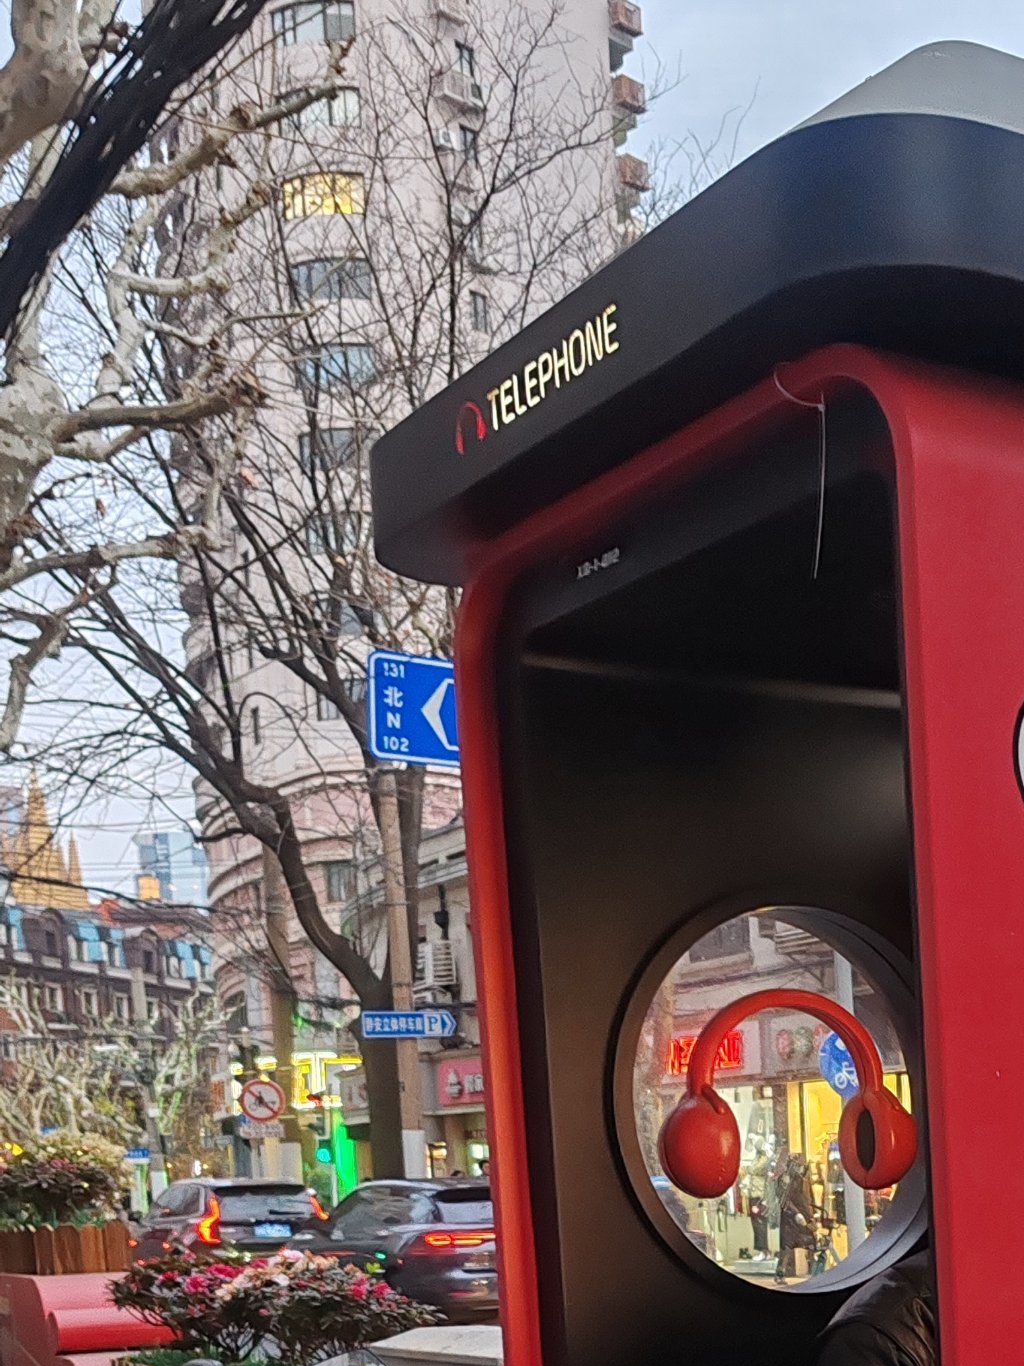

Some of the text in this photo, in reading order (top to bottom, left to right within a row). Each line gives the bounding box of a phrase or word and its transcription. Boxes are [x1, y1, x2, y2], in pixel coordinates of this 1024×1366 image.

[486, 304, 620, 431] TELEPHONE
[383, 662, 405, 678] 131
[383, 686, 404, 708] 北
[386, 711, 402, 729] N
[383, 735, 410, 752] 102
